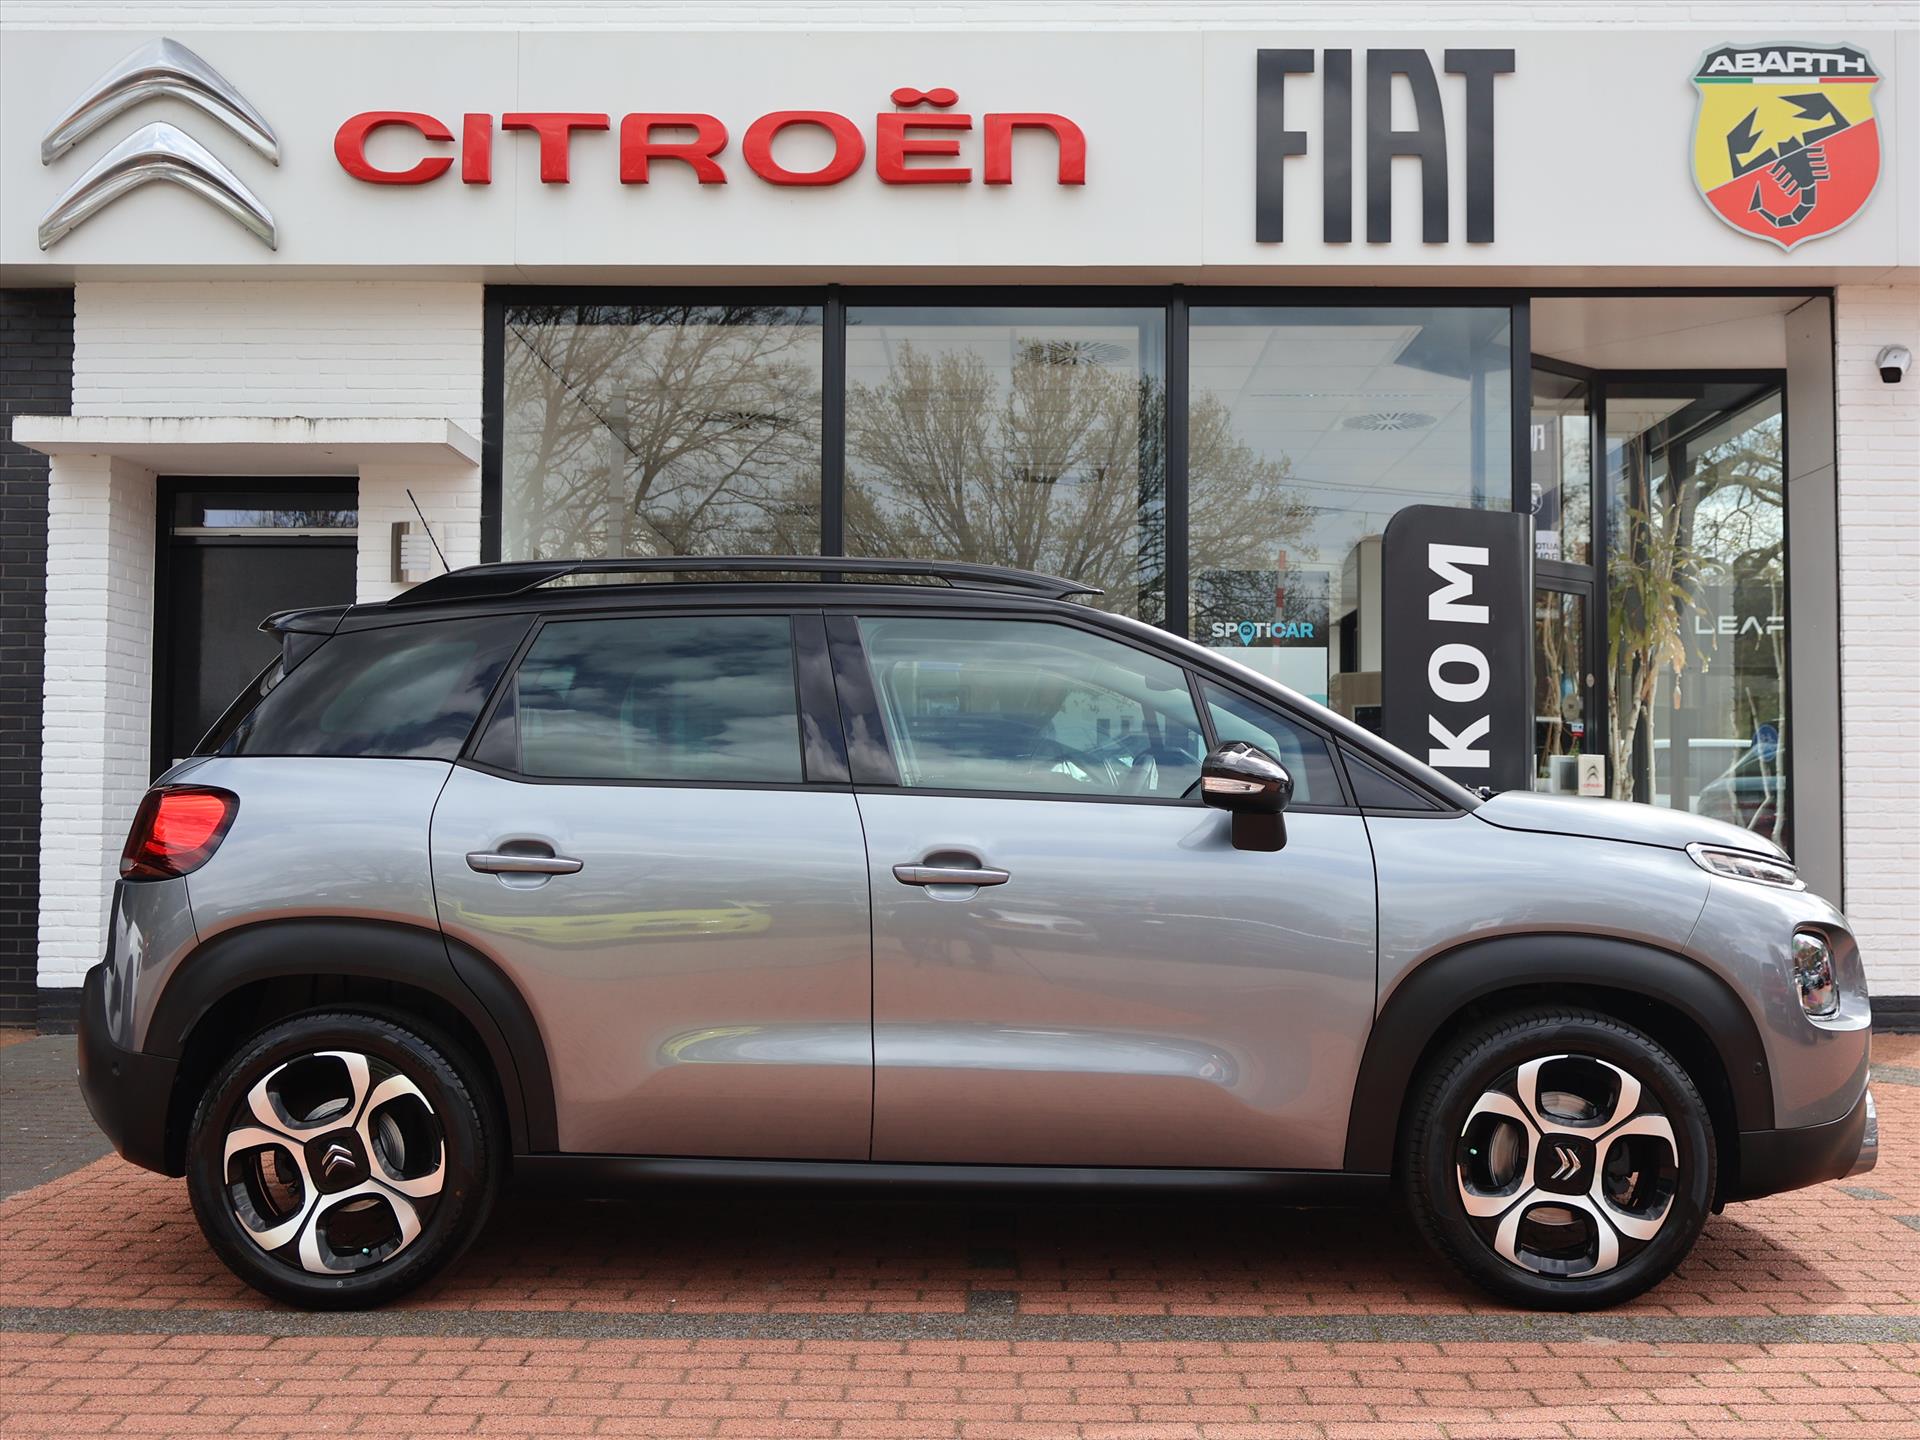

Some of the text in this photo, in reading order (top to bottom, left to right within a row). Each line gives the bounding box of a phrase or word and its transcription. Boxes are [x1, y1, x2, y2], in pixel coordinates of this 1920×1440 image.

[1256, 48, 1516, 243] FIAT
[1706, 51, 1866, 73] ABARTH
[1428, 543, 1490, 768] KOM
